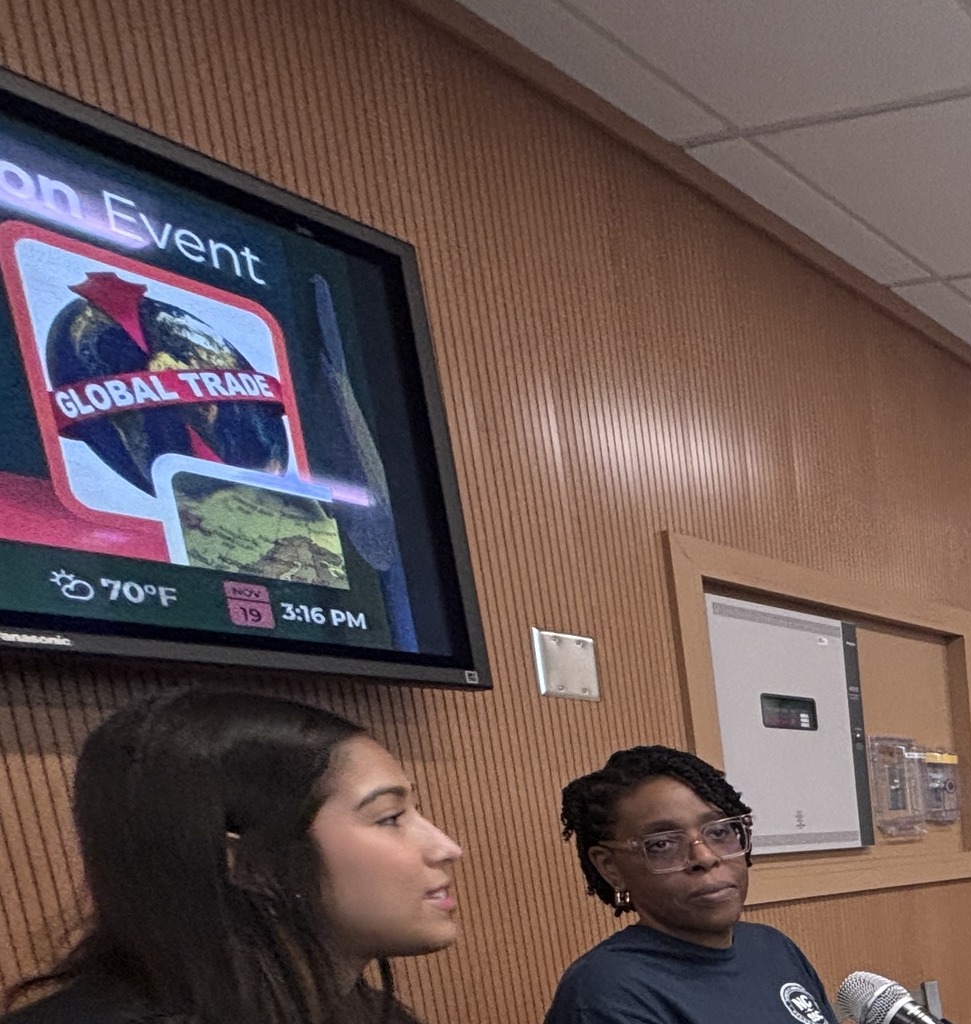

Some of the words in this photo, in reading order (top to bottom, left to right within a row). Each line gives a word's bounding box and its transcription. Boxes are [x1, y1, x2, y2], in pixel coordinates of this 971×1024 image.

[102, 190, 267, 286] Event
[55, 375, 180, 419] GLOBAL
[177, 371, 276, 399] TRADE
[100, 578, 178, 607] 70°F
[229, 587, 264, 599] NOV
[239, 605, 263, 623] 19
[280, 603, 327, 625] 3:16
[330, 608, 369, 631] PM
